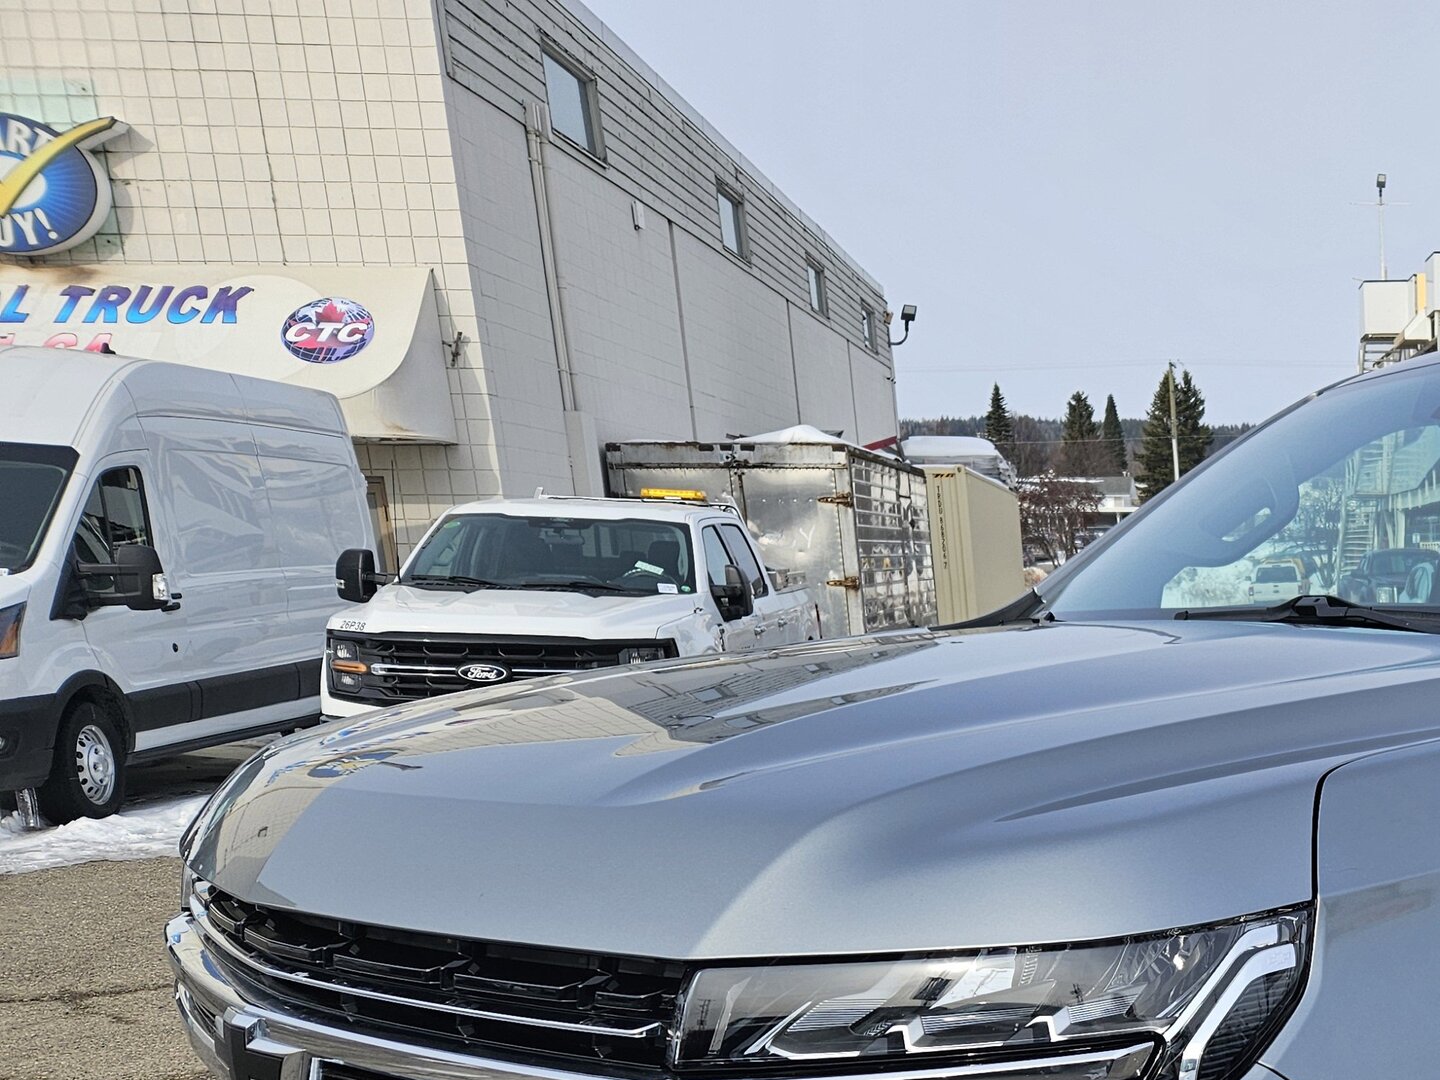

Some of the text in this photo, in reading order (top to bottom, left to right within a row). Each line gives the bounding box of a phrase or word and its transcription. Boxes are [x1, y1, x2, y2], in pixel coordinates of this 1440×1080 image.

[53, 284, 255, 324] TRUCK
[285, 321, 368, 342] CTC
[340, 620, 366, 631] 26P38
[467, 666, 497, 679] Ford
